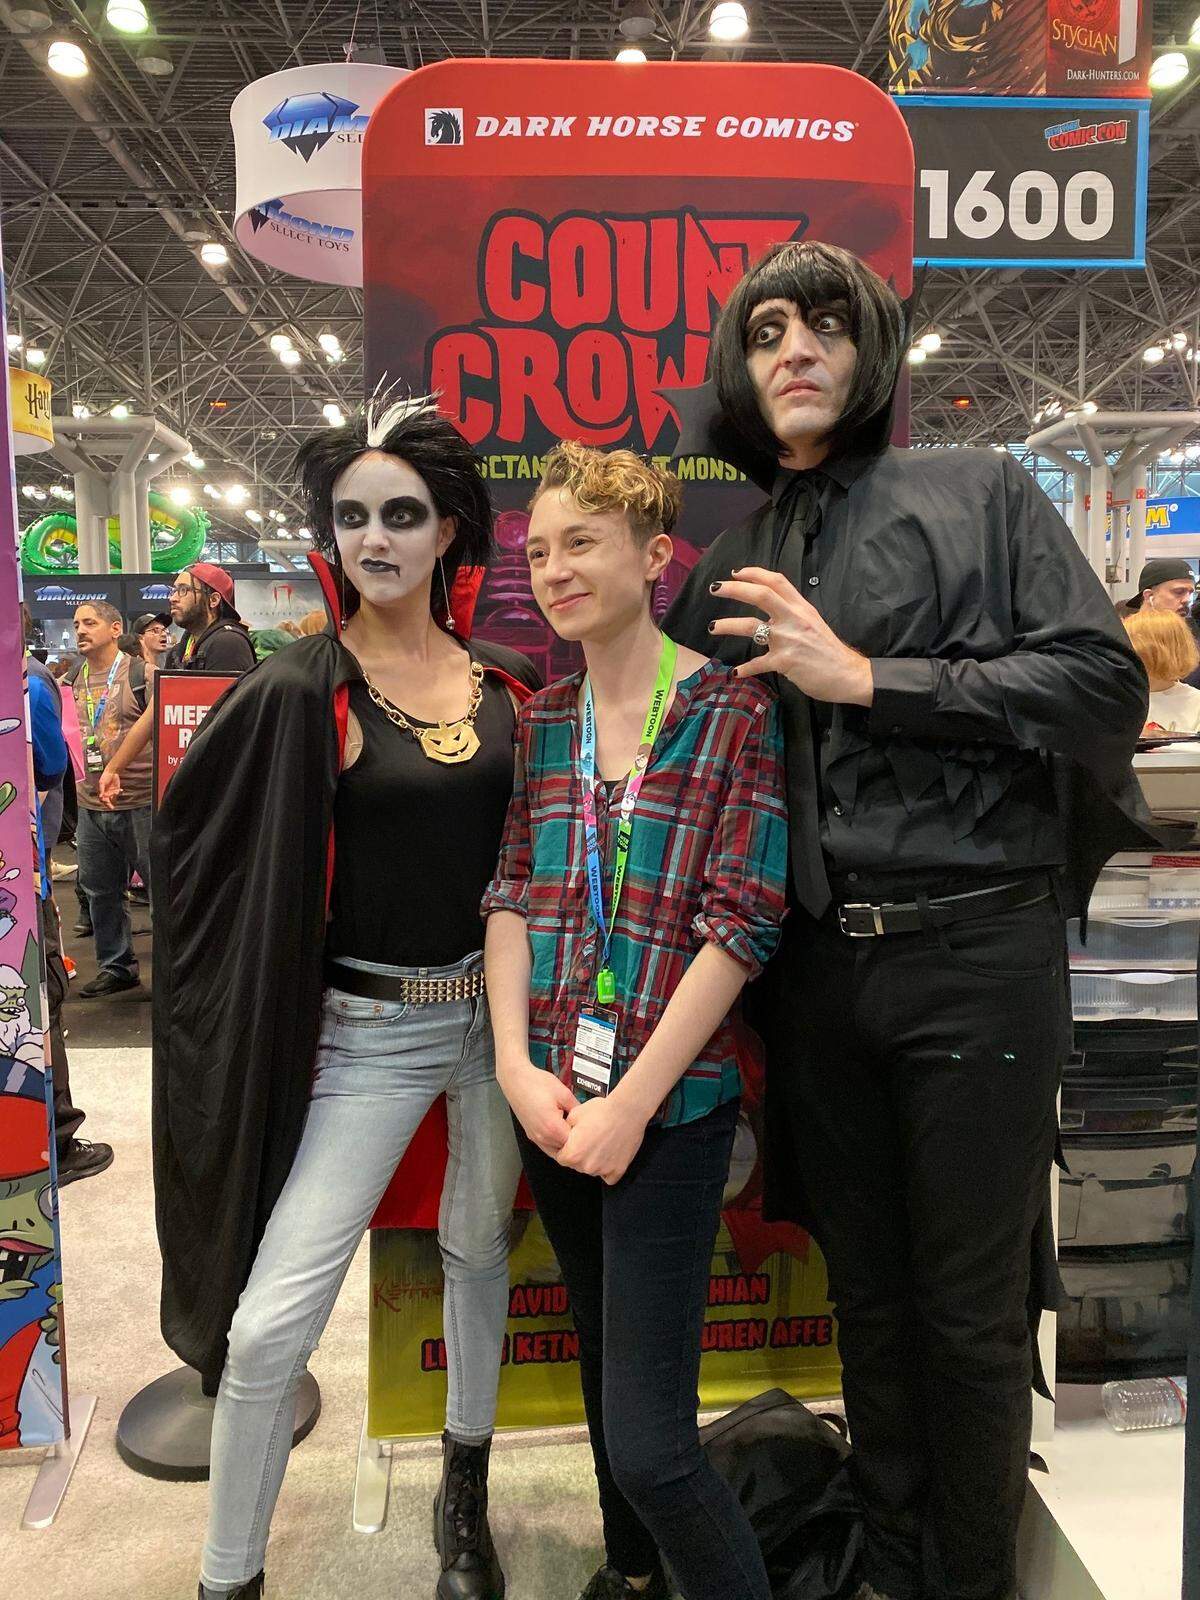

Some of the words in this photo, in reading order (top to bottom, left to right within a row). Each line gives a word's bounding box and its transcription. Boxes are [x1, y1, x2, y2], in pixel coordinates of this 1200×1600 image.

[1052, 18, 1117, 56] STYGIAN
[475, 116, 577, 137] DARK
[587, 115, 706, 137] HORSE
[715, 116, 856, 142] COMICS
[1050, 127, 1096, 149] COMIC
[1097, 122, 1126, 142] CON
[920, 169, 1114, 241] 1600
[270, 222, 313, 244] SELECT
[319, 238, 350, 253] TOYS
[677, 456, 747, 481] MONS
[37, 592, 108, 601] DIAMOND
[585, 700, 593, 744] WEBTOON
[646, 689, 665, 737] WEBTOON
[591, 865, 601, 918] WEBTOON
